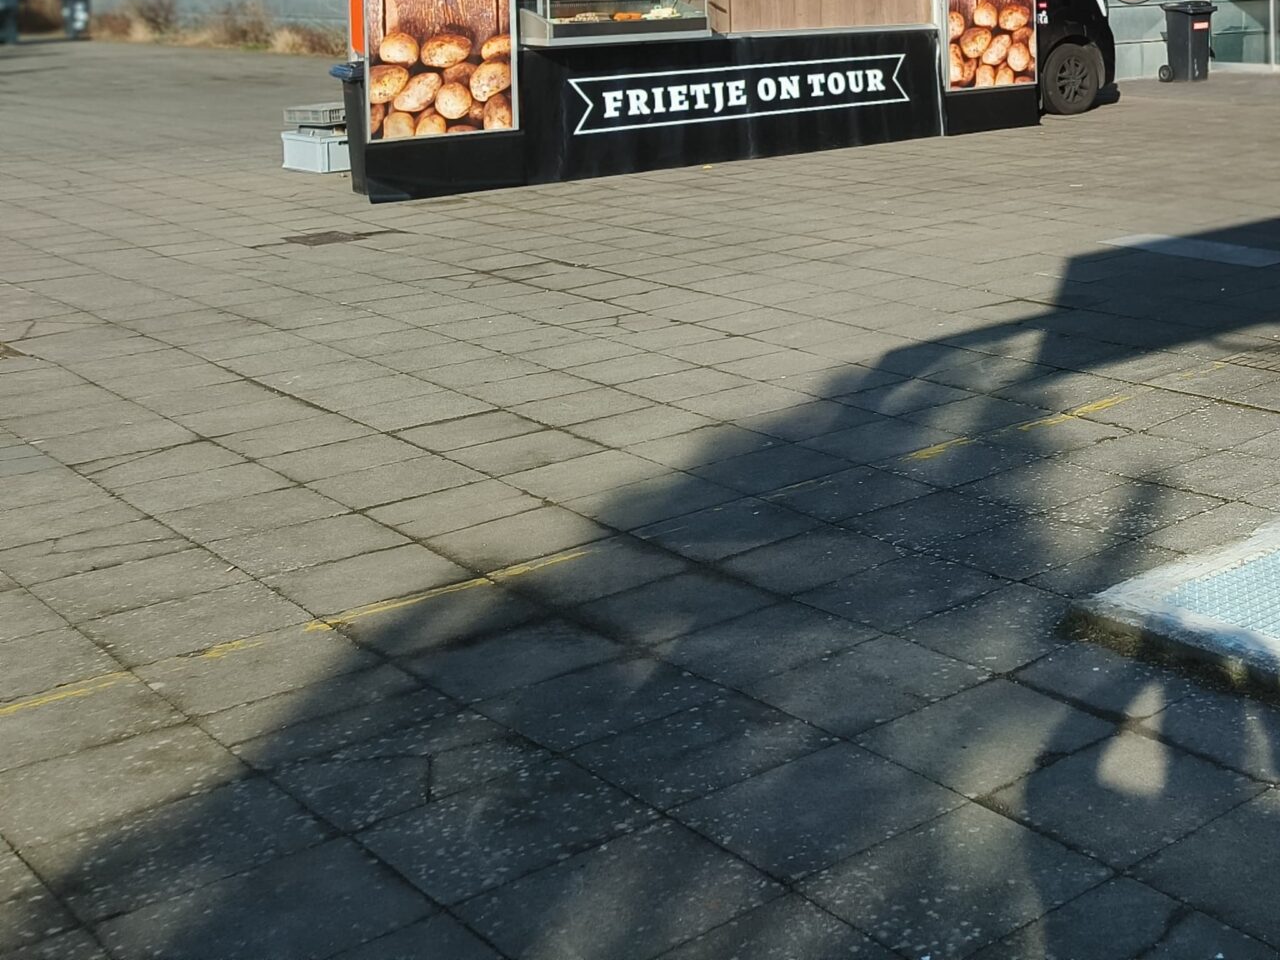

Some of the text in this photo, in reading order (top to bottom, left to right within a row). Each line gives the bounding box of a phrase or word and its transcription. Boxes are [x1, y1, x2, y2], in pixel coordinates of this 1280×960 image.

[602, 68, 886, 119] FRIETJE ON TOUR
